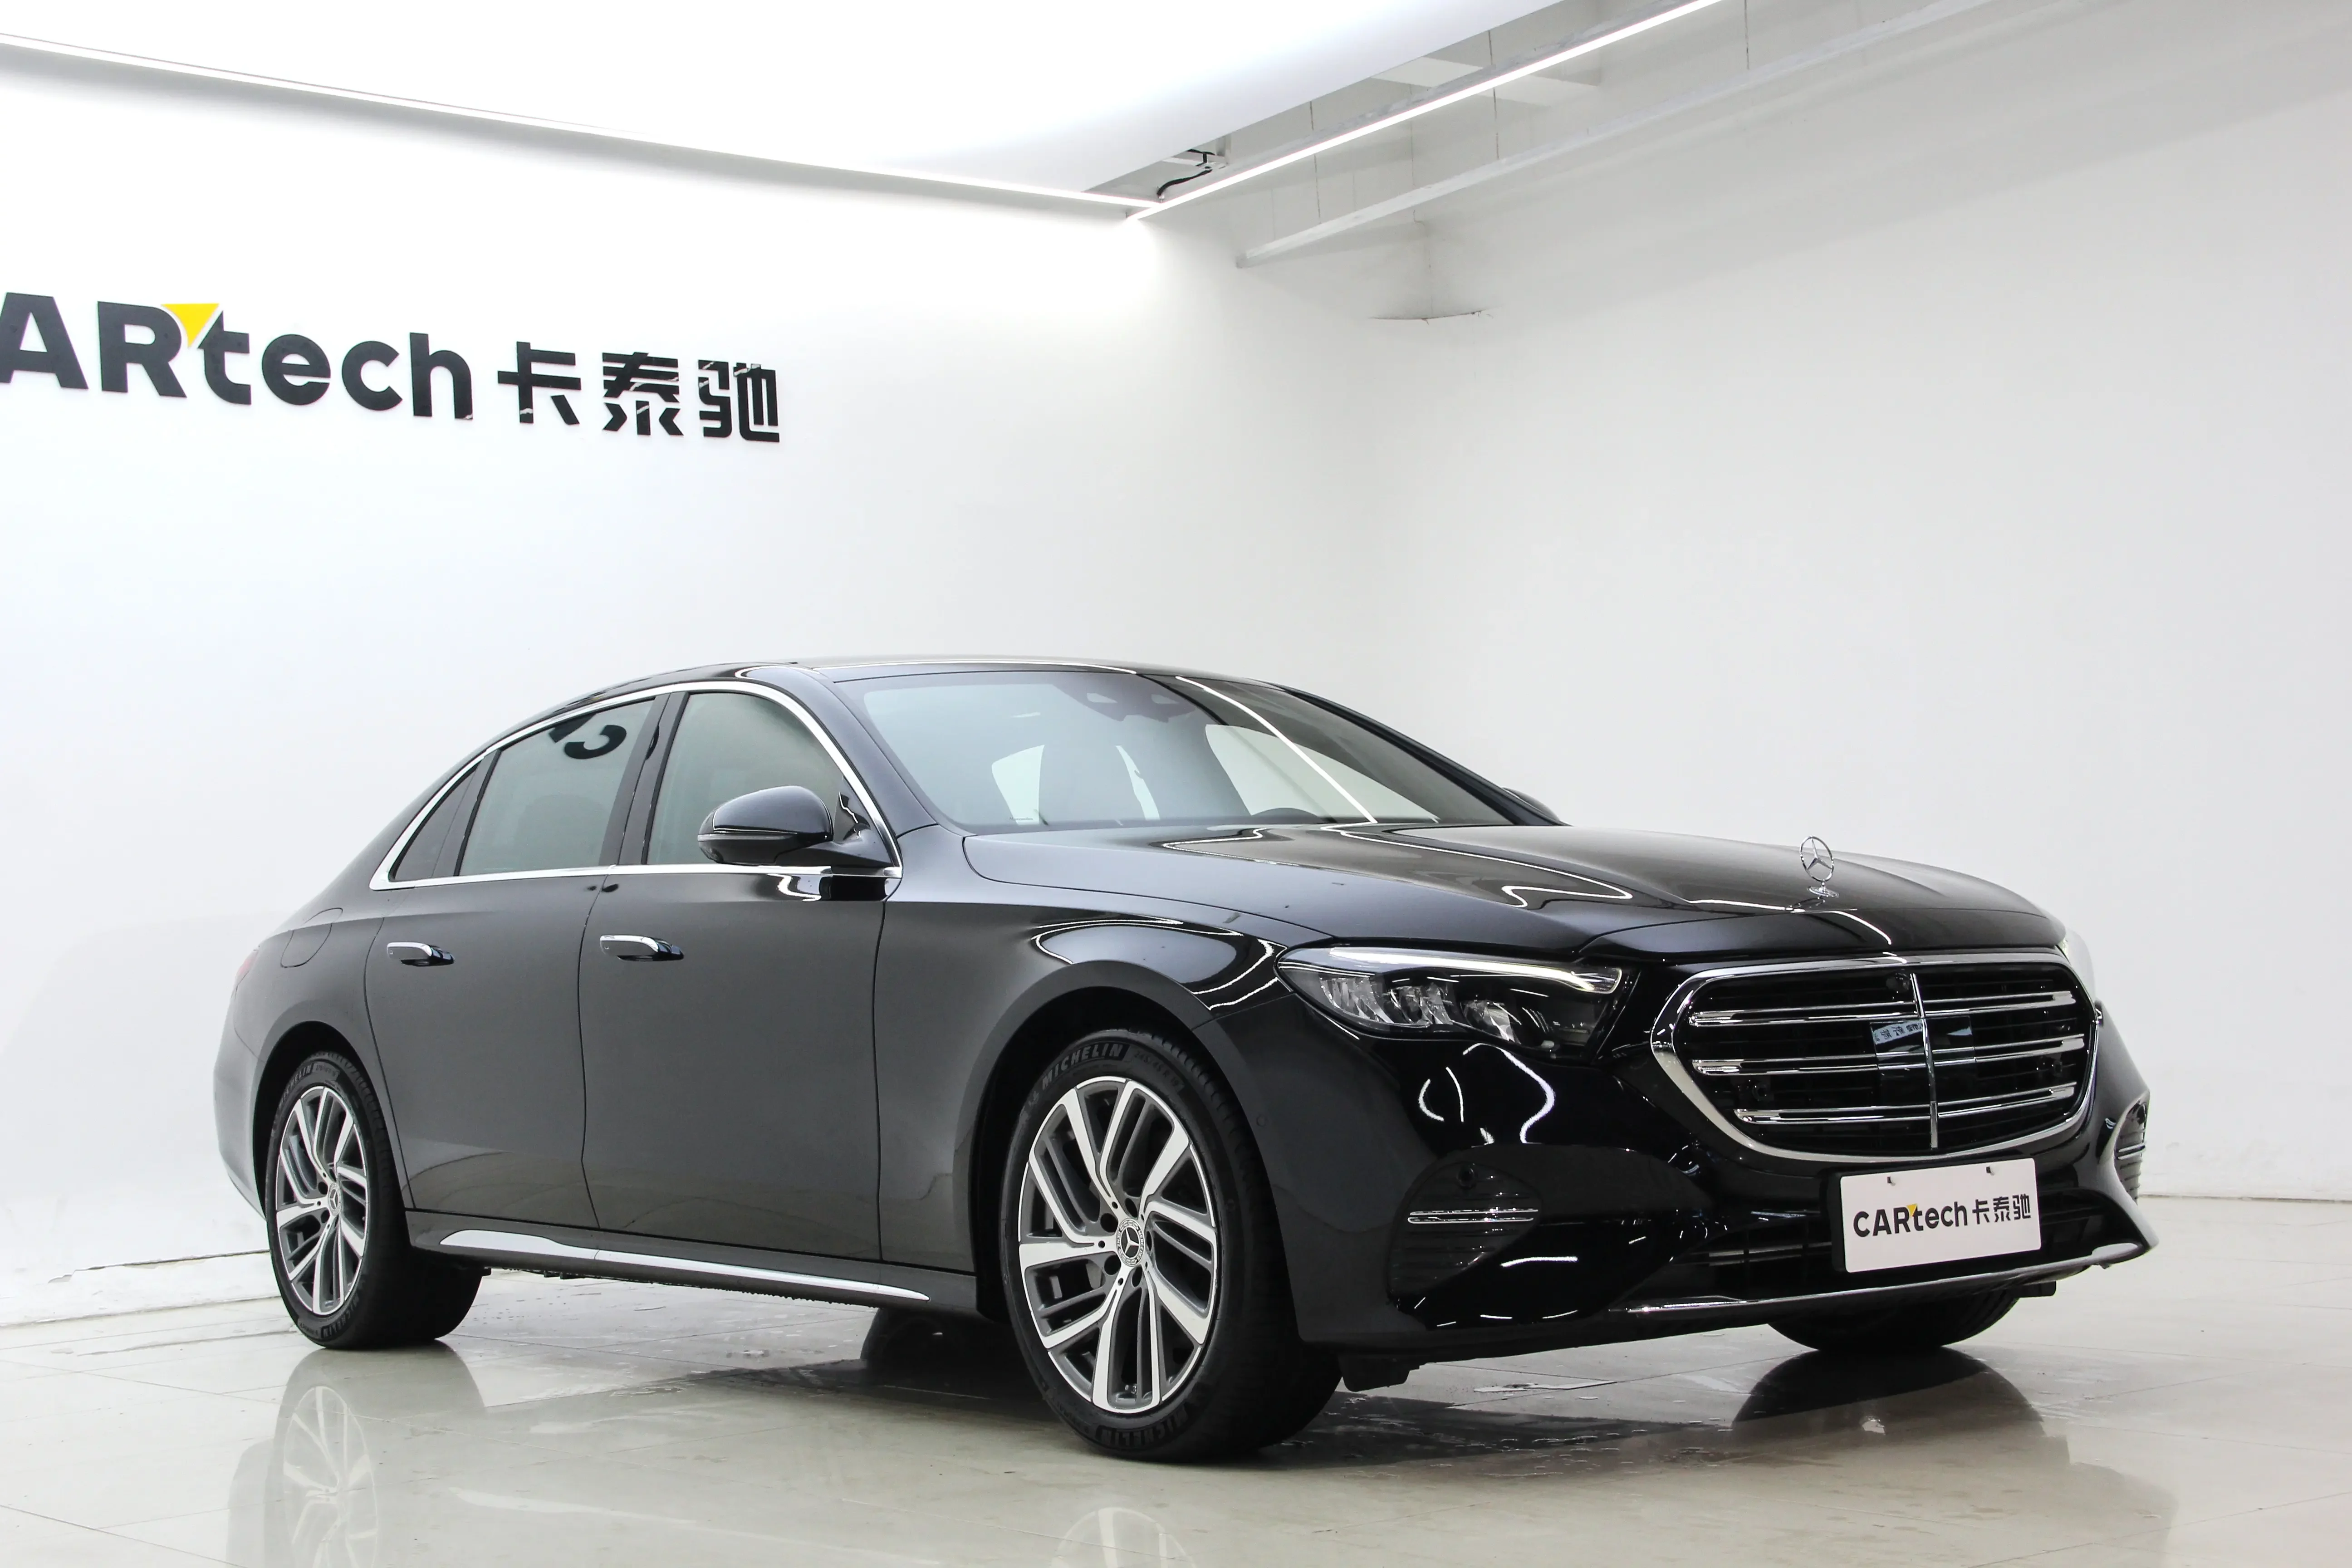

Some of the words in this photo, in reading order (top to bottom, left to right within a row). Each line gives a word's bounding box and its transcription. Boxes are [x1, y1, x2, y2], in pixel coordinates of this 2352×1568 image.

[498, 342, 779, 442] 卡泰驰
[1042, 1043, 1123, 1091] MICHELIN
[1853, 1201, 1967, 1237] CARtech
[1972, 1194, 2031, 1224] 卡泰驰
[1099, 1405, 1189, 1448] MICHELIN
